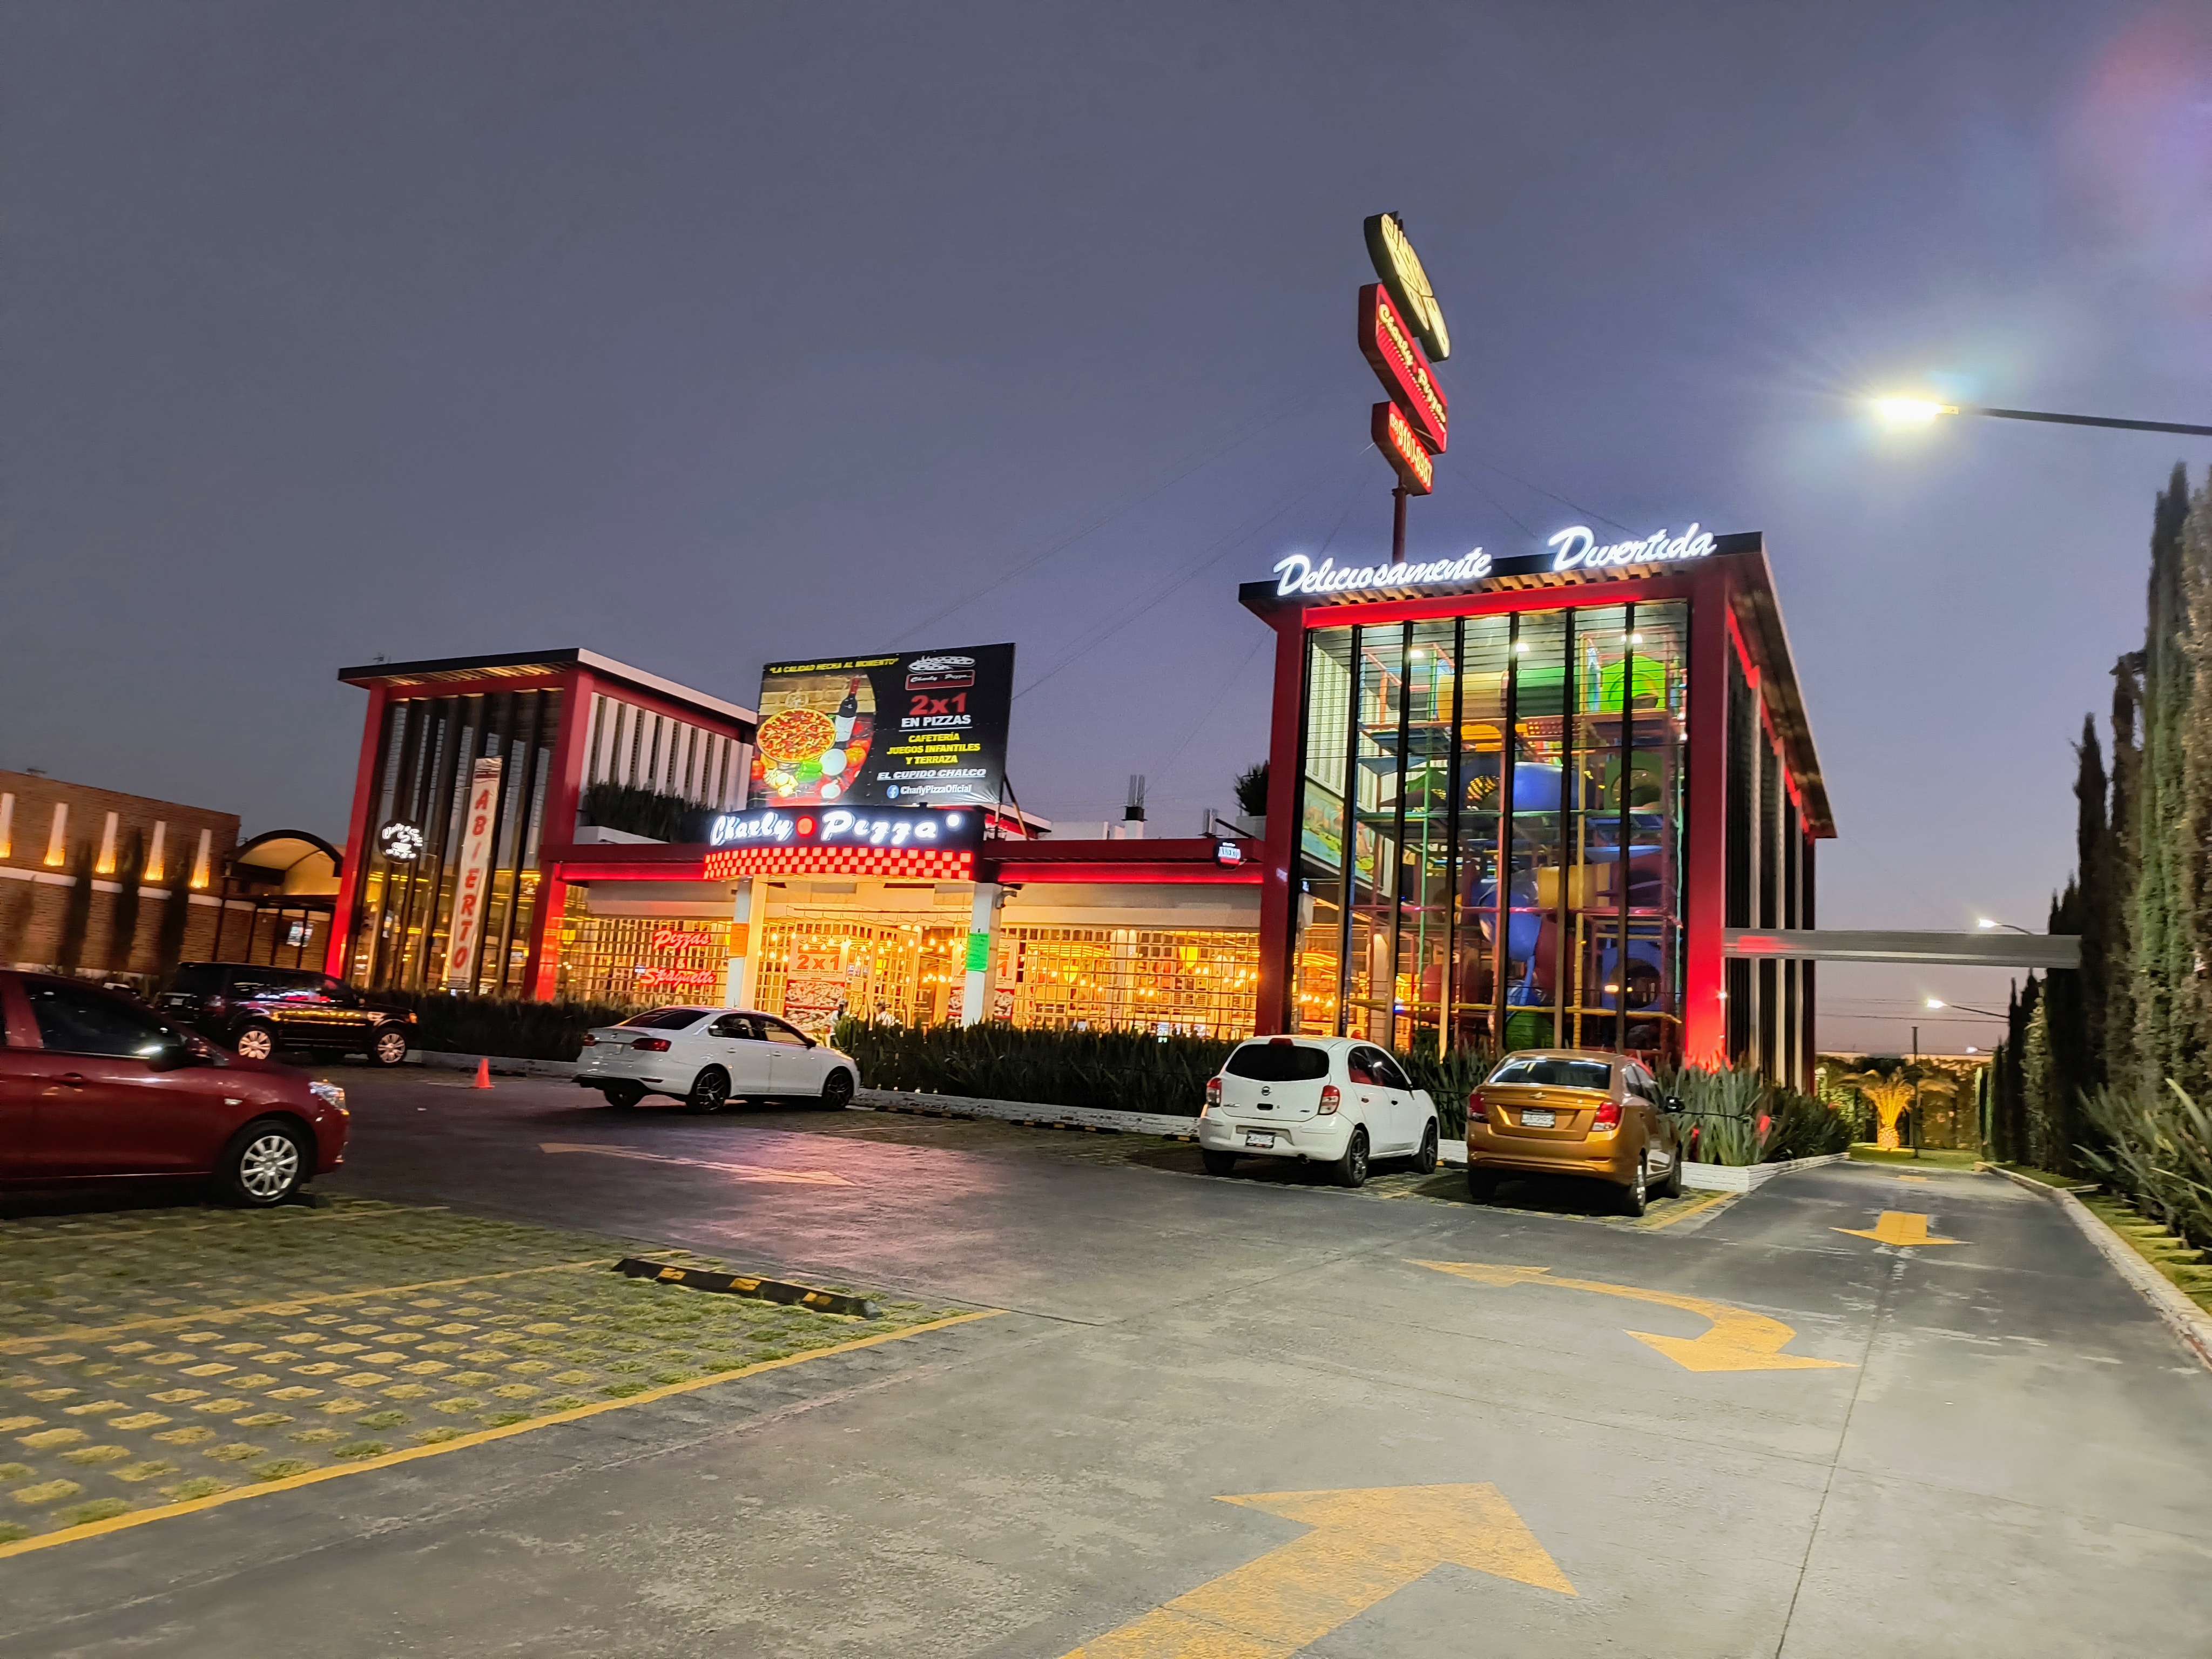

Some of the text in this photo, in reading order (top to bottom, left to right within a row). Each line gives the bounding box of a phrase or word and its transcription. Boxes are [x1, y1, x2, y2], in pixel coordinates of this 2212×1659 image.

[1379, 304, 1446, 423] Charly Pizza
[1273, 523, 1717, 596] Deliciosamente Divertida
[909, 692, 967, 716] 2x1
[901, 714, 972, 727] EN PIZZAS
[908, 732, 960, 743] CAFETERÍA
[886, 743, 981, 754] JUEGOS INFANTILES
[906, 755, 958, 765] Y TERRAZA
[877, 768, 987, 780] EL CUPIDO CHALCO
[900, 784, 972, 795] CharlyPizzaOficial
[710, 810, 939, 846] Charly Pizza
[451, 788, 491, 969] ABIERTO
[653, 929, 710, 950] Pizzas
[676, 958, 685, 969] &
